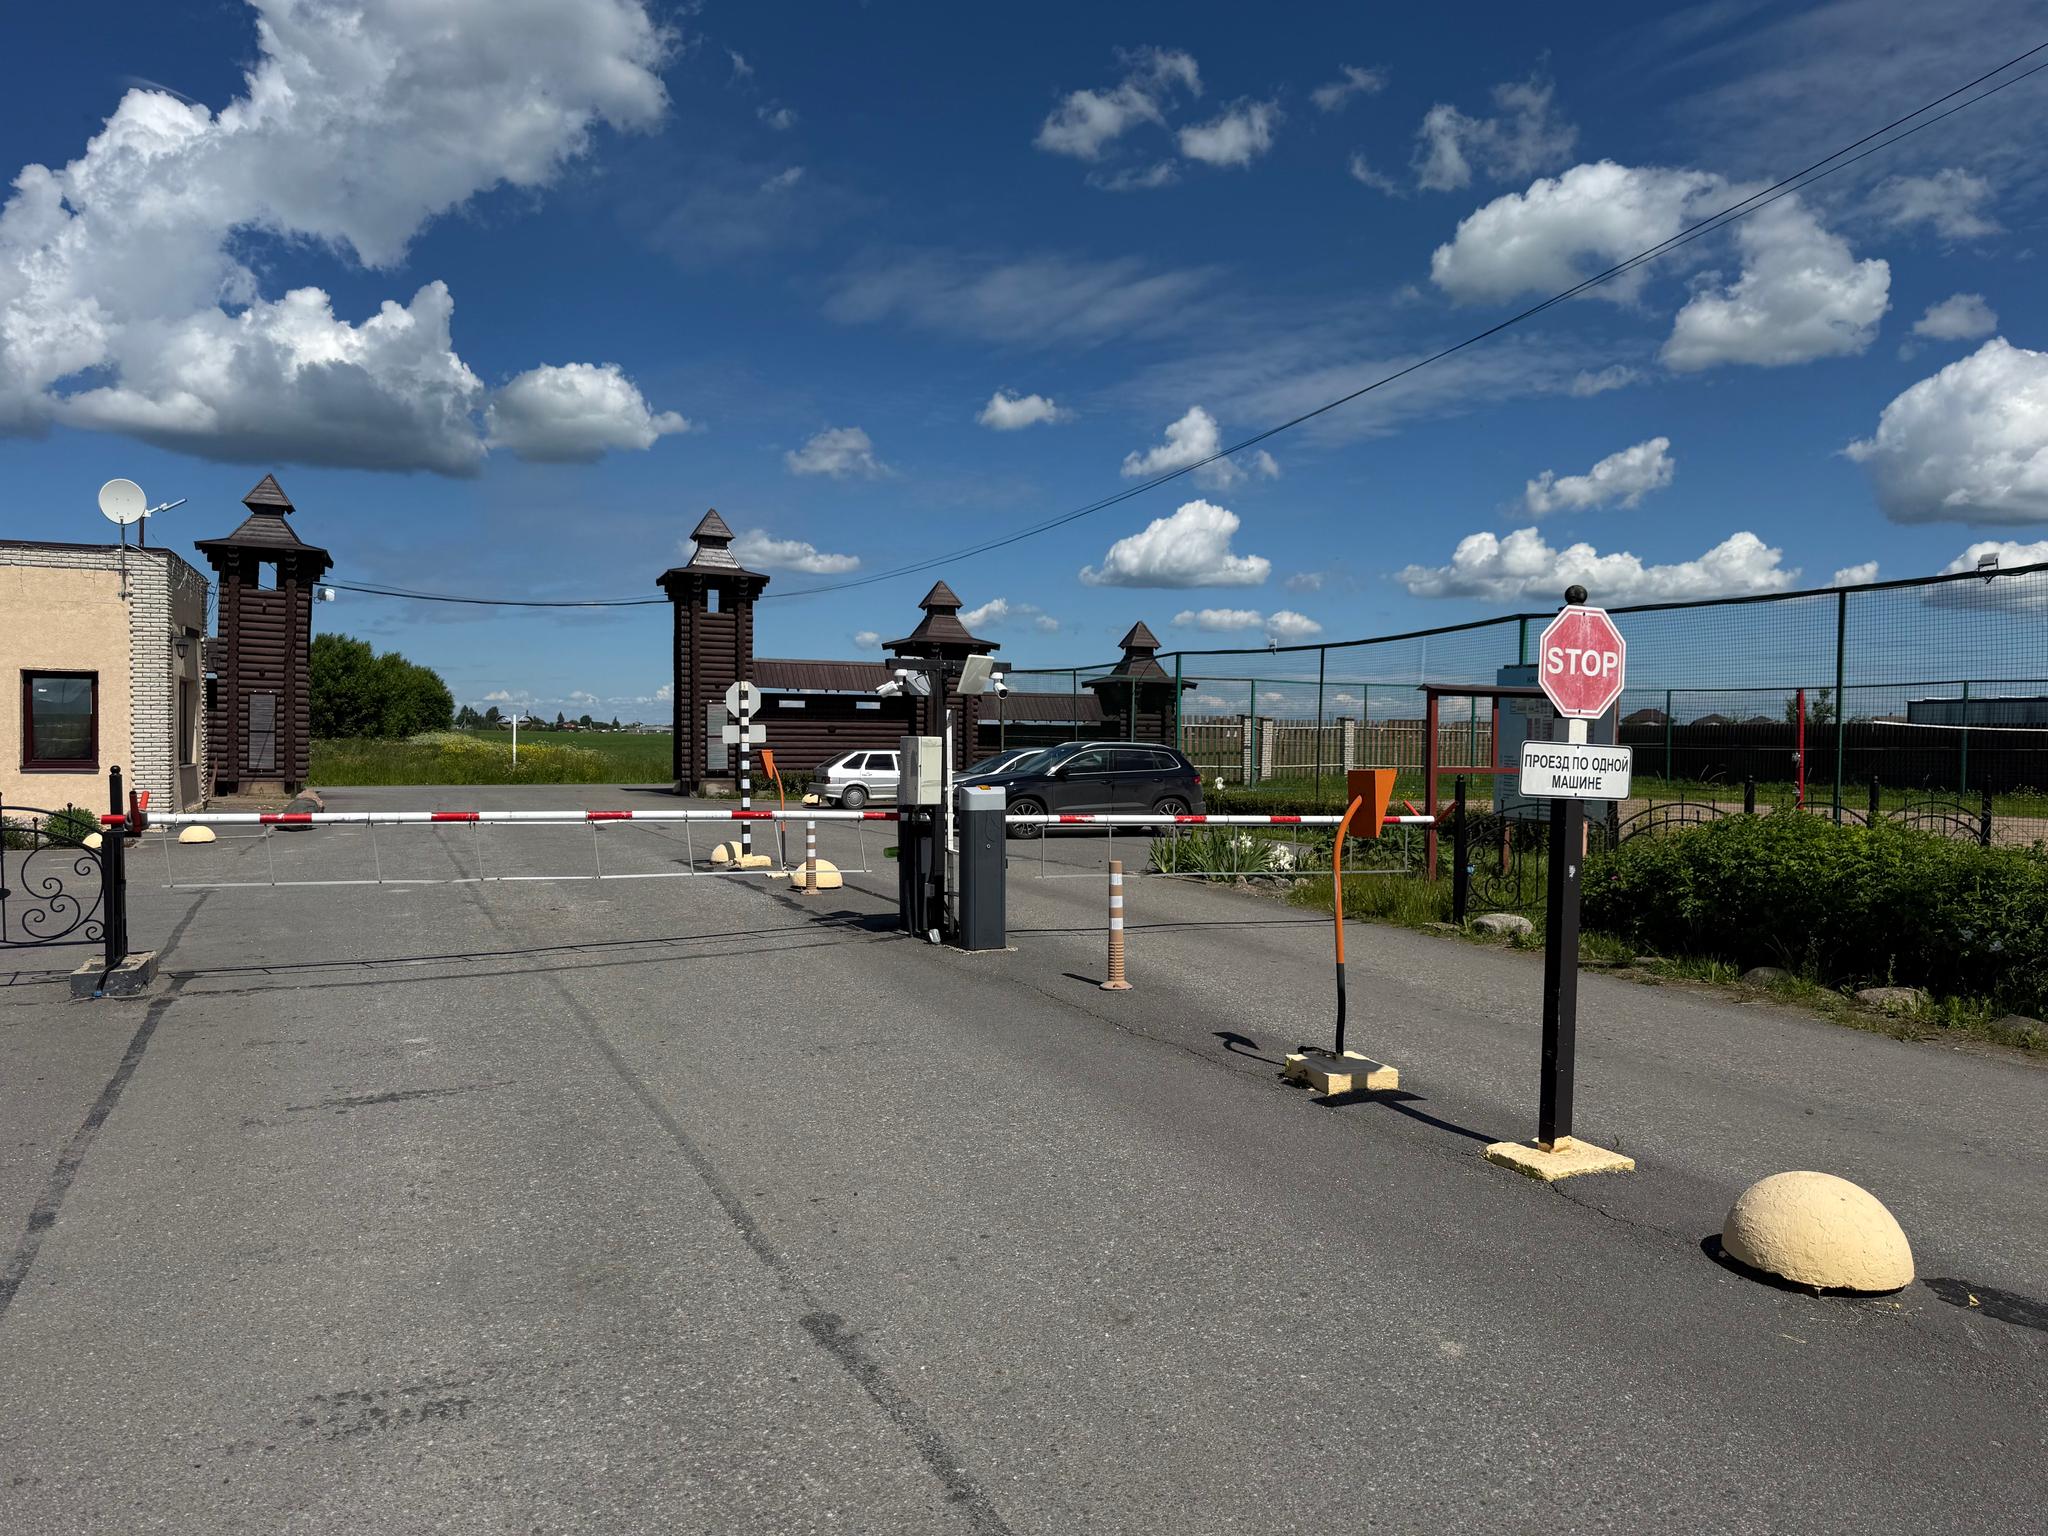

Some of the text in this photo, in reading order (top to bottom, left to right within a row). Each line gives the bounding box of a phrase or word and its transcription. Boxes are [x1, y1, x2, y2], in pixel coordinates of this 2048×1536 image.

[1546, 646, 1618, 678] STOP
[1524, 754, 1569, 772] ПРОЕЗД
[1572, 756, 1588, 770] ПО
[1592, 755, 1628, 774] ОДНОЙ
[1552, 775, 1602, 790] МАШИНЕ
